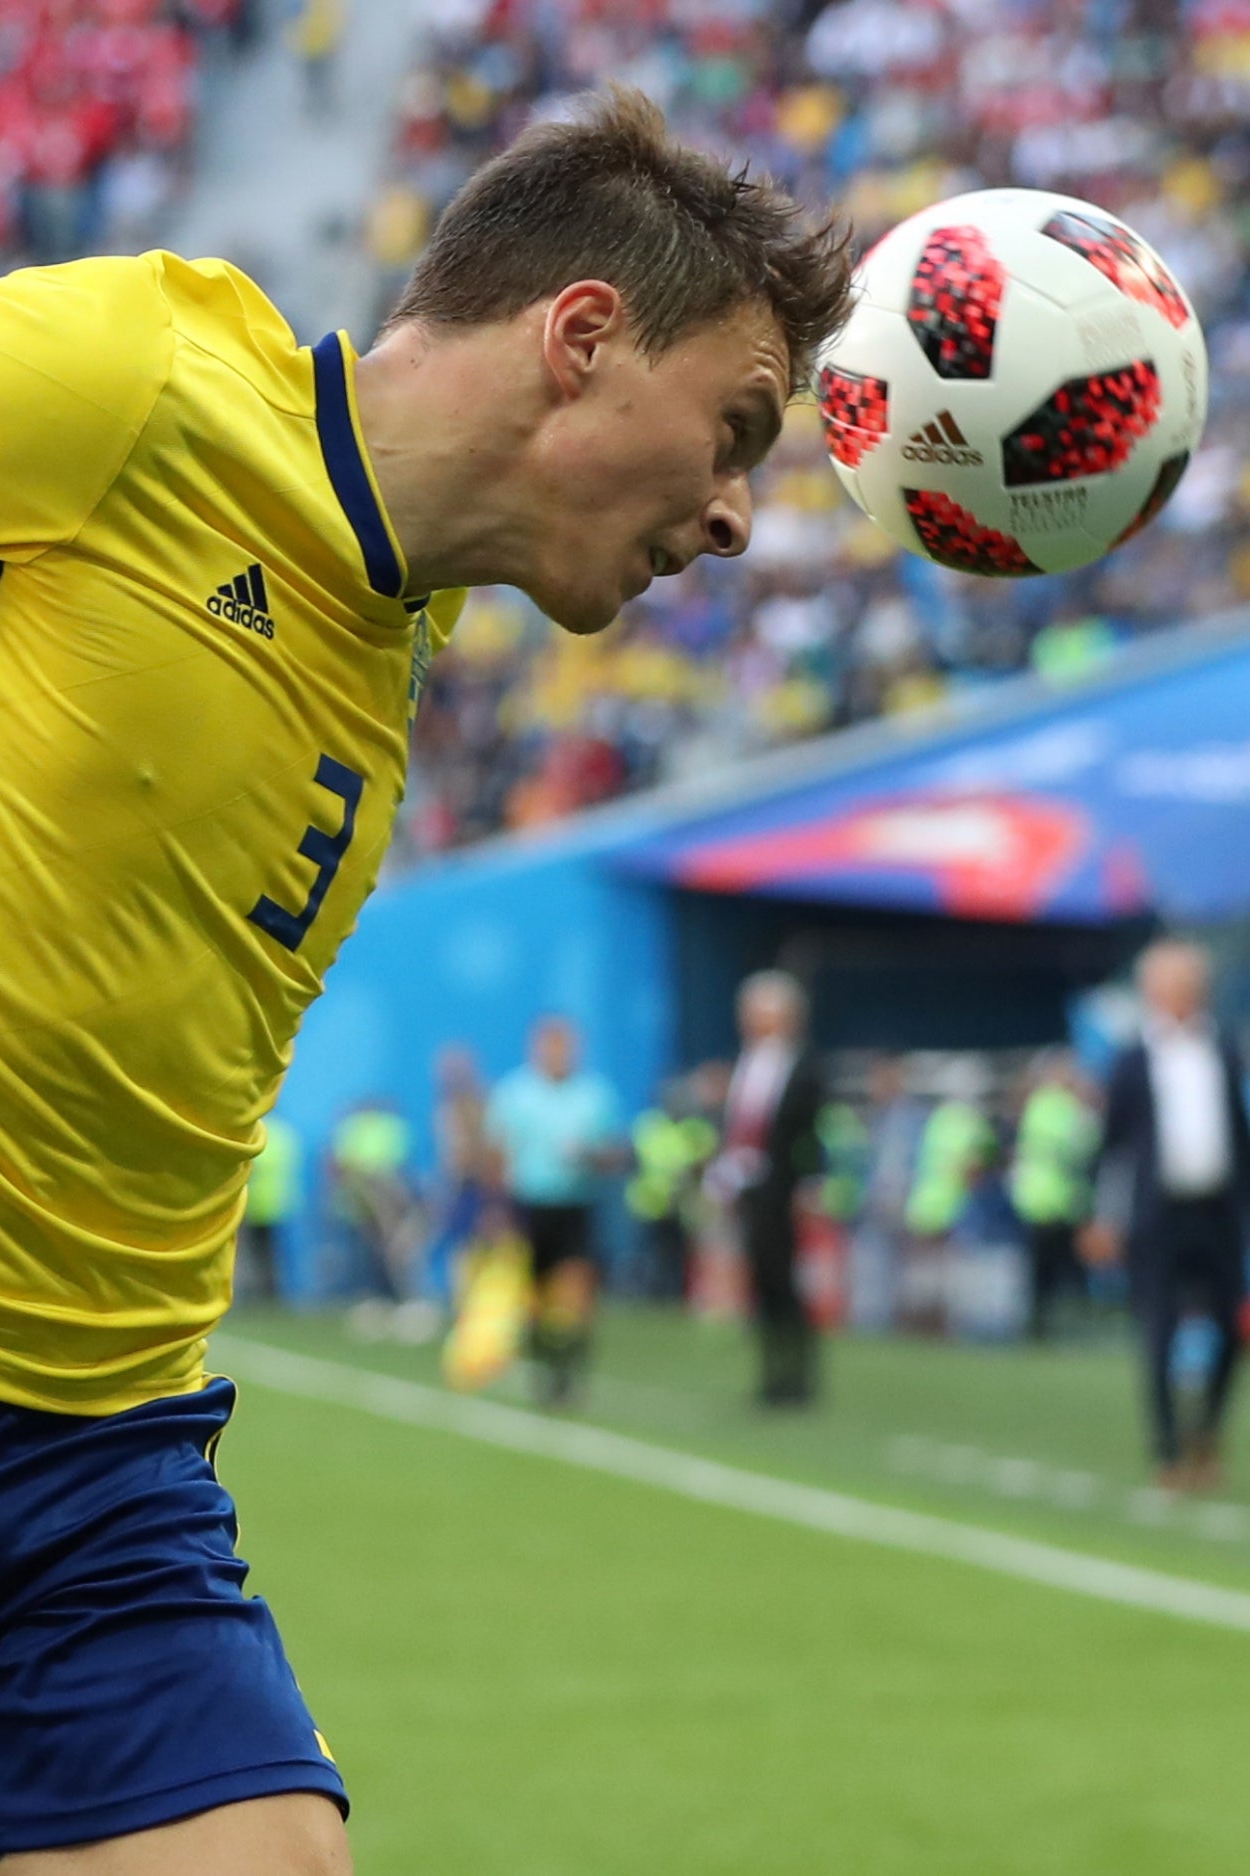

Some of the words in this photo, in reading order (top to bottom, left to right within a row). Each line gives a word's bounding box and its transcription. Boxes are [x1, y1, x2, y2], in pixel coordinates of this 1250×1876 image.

[901, 441, 984, 466] adidas
[207, 596, 274, 640] adidas
[245, 752, 365, 953] 3
